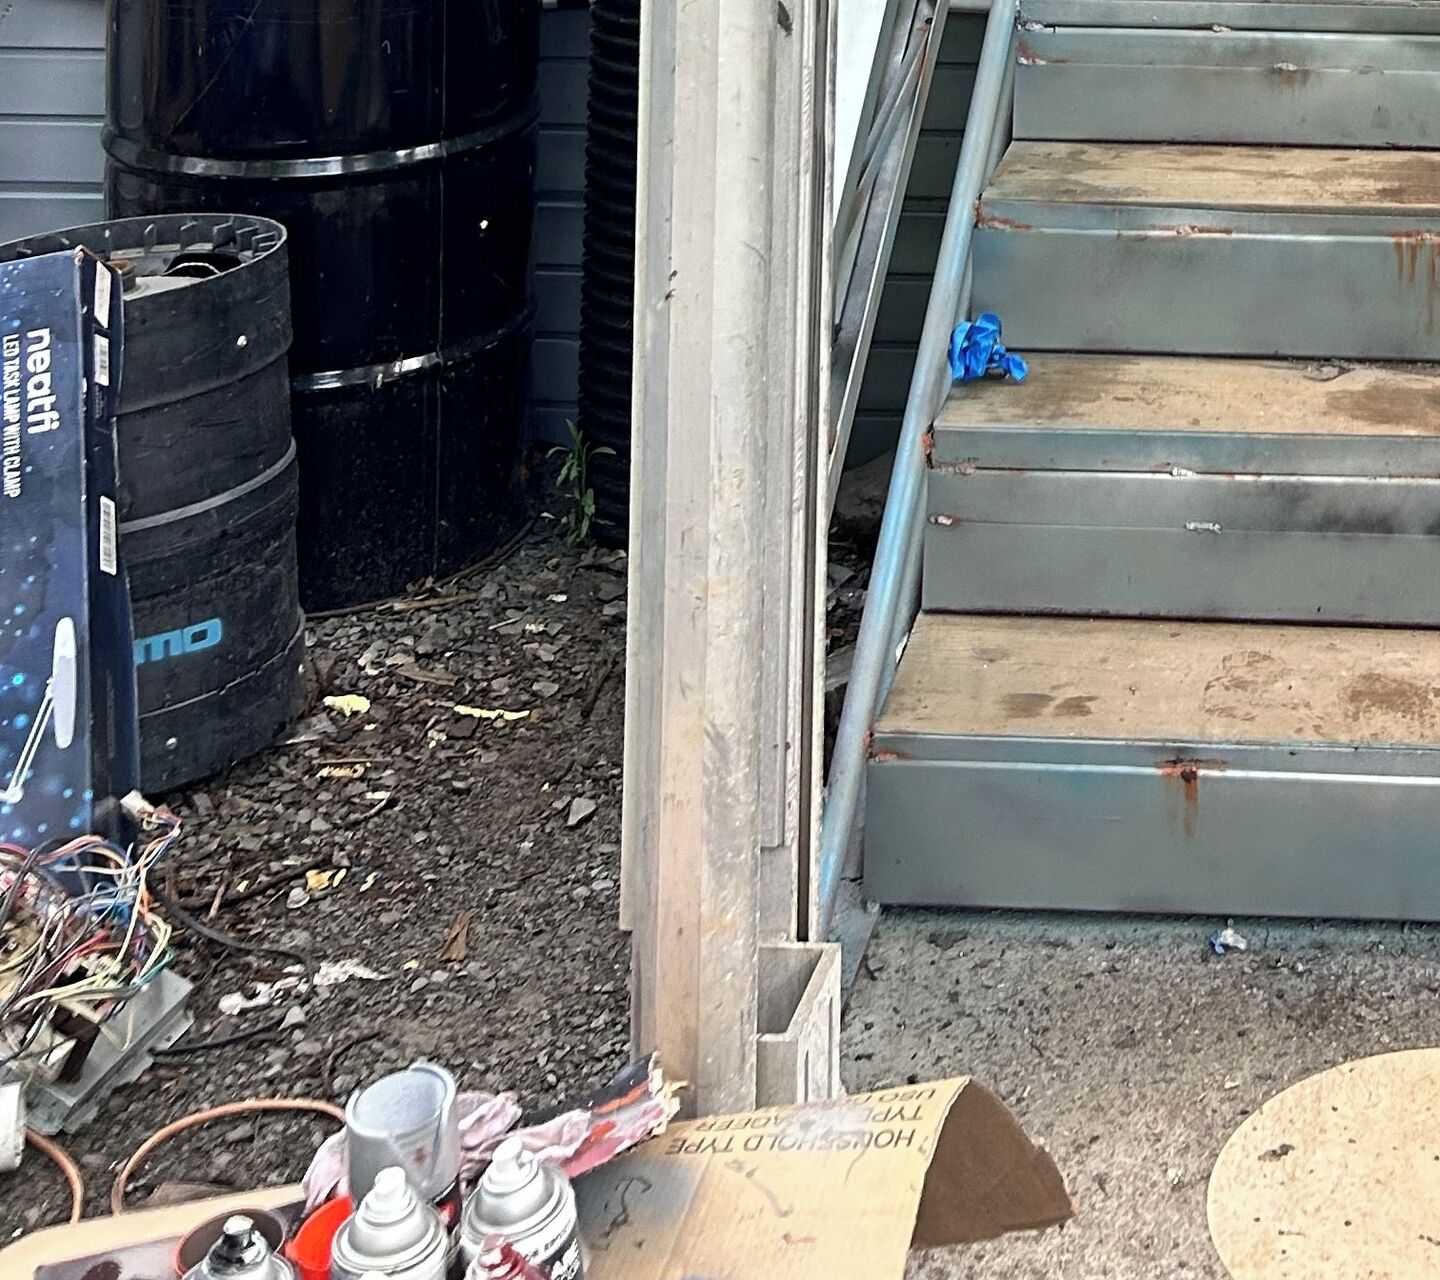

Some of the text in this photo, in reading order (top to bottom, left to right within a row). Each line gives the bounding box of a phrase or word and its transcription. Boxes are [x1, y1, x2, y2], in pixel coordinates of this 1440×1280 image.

[3, 334, 21, 497] LED TASK LAMP WITH CLAMP
[26, 328, 60, 434] neatfi
[665, 1136, 733, 1156] TYPE
